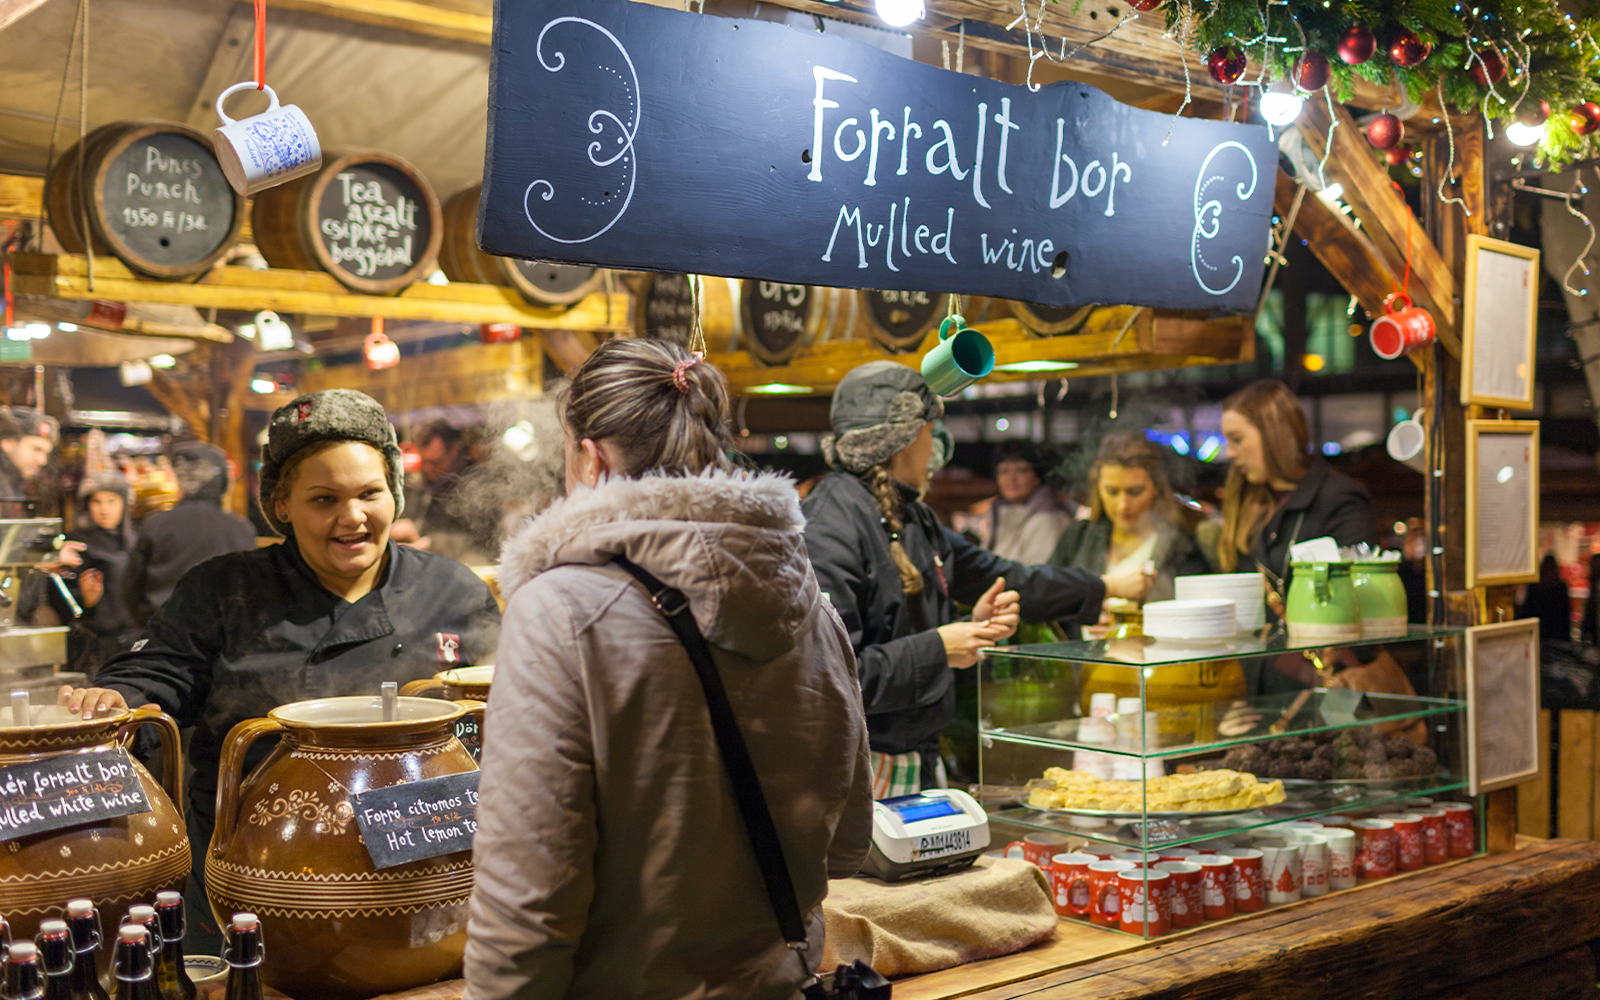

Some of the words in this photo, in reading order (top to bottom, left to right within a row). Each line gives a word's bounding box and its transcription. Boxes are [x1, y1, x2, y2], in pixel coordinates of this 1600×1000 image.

[807, 65, 1020, 209] Forralt
[1049, 117, 1132, 217] bor
[146, 145, 203, 179] Puncs
[127, 172, 201, 204] Punch
[336, 172, 387, 206] Tea
[122, 207, 158, 228] 1350
[821, 196, 957, 272] Mulled
[981, 228, 1055, 274] wine
[33, 762, 93, 798] forralt
[98, 762, 128, 782] bor
[0, 801, 45, 830] ulled
[49, 795, 95, 817] white
[101, 791, 142, 810] wine
[364, 802, 401, 826] Forró
[408, 795, 462, 816] citromos
[465, 788, 479, 805] te
[386, 830, 416, 851] Hot
[421, 826, 463, 843] lemon
[463, 818, 478, 833] te
